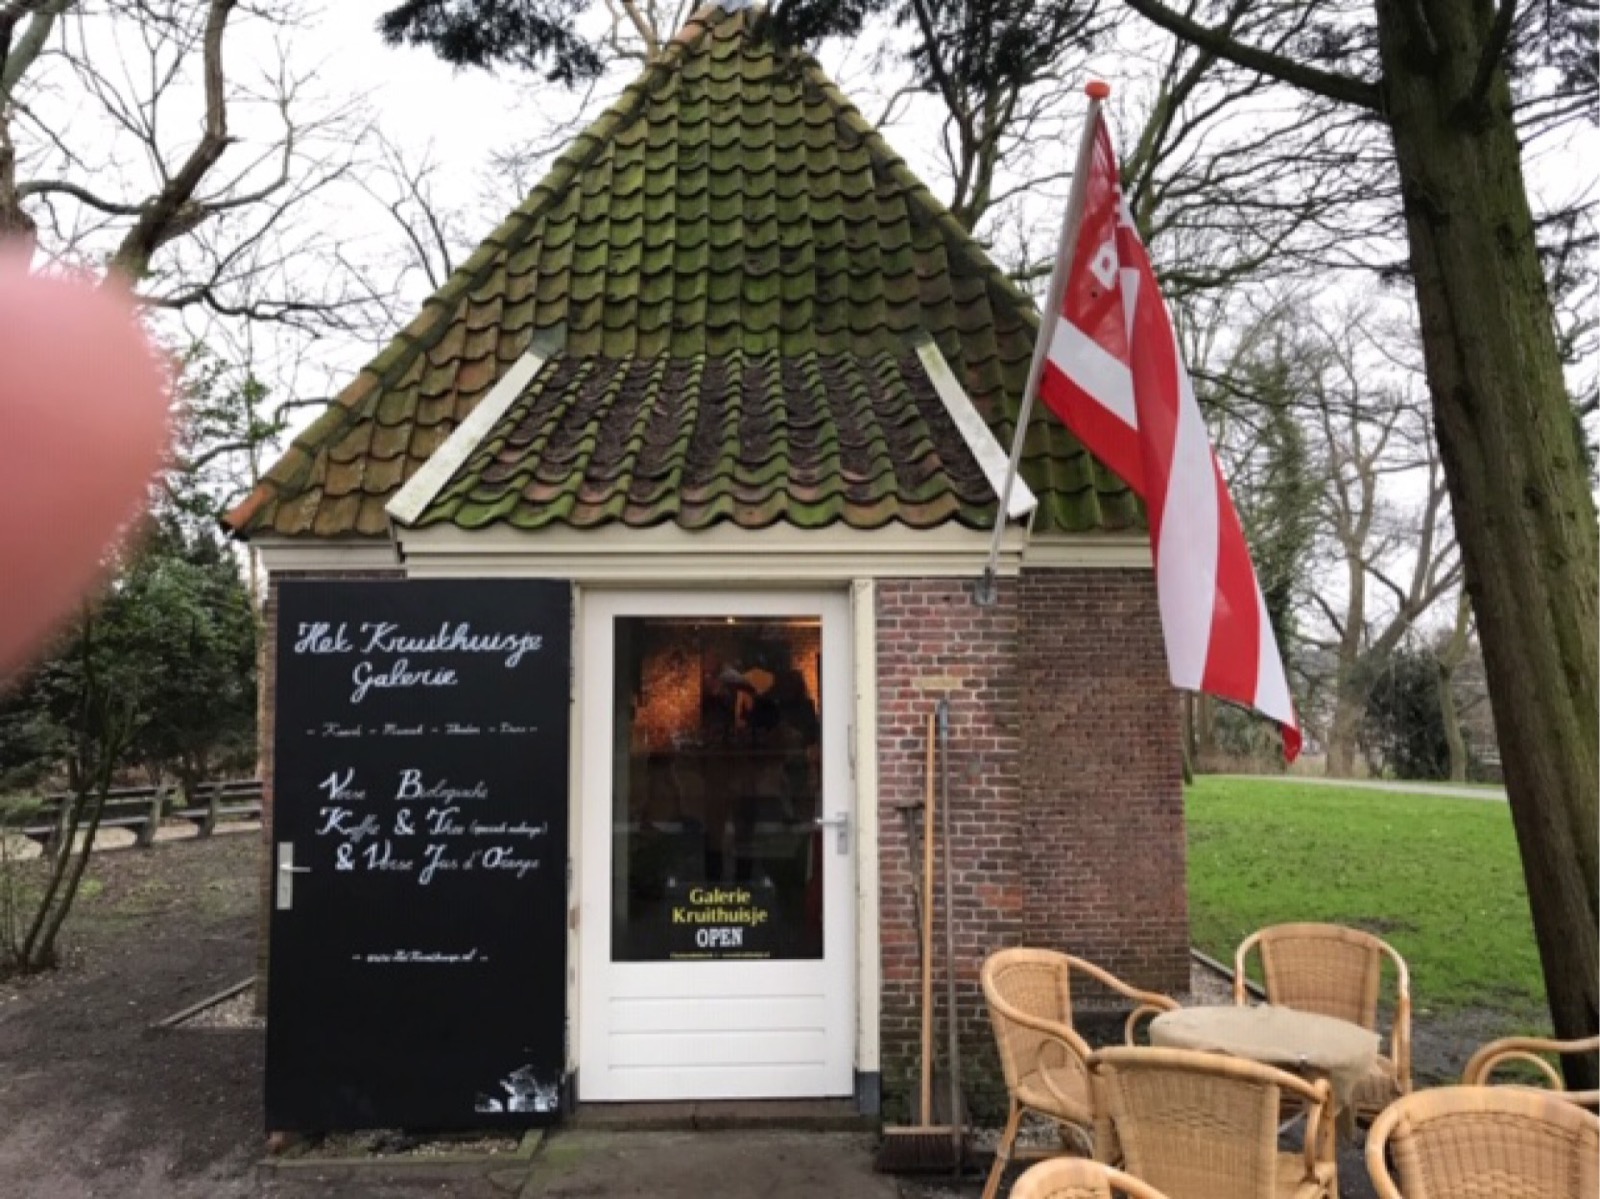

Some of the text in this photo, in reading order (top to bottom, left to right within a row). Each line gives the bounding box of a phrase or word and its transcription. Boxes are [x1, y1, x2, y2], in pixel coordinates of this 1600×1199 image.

[295, 622, 353, 654] Het
[349, 658, 459, 703] Galerie
[393, 808, 415, 836] &
[335, 842, 355, 871] &
[689, 886, 751, 905] Galerie
[672, 906, 769, 927] Kruithuisje
[695, 926, 744, 948] OPEN
